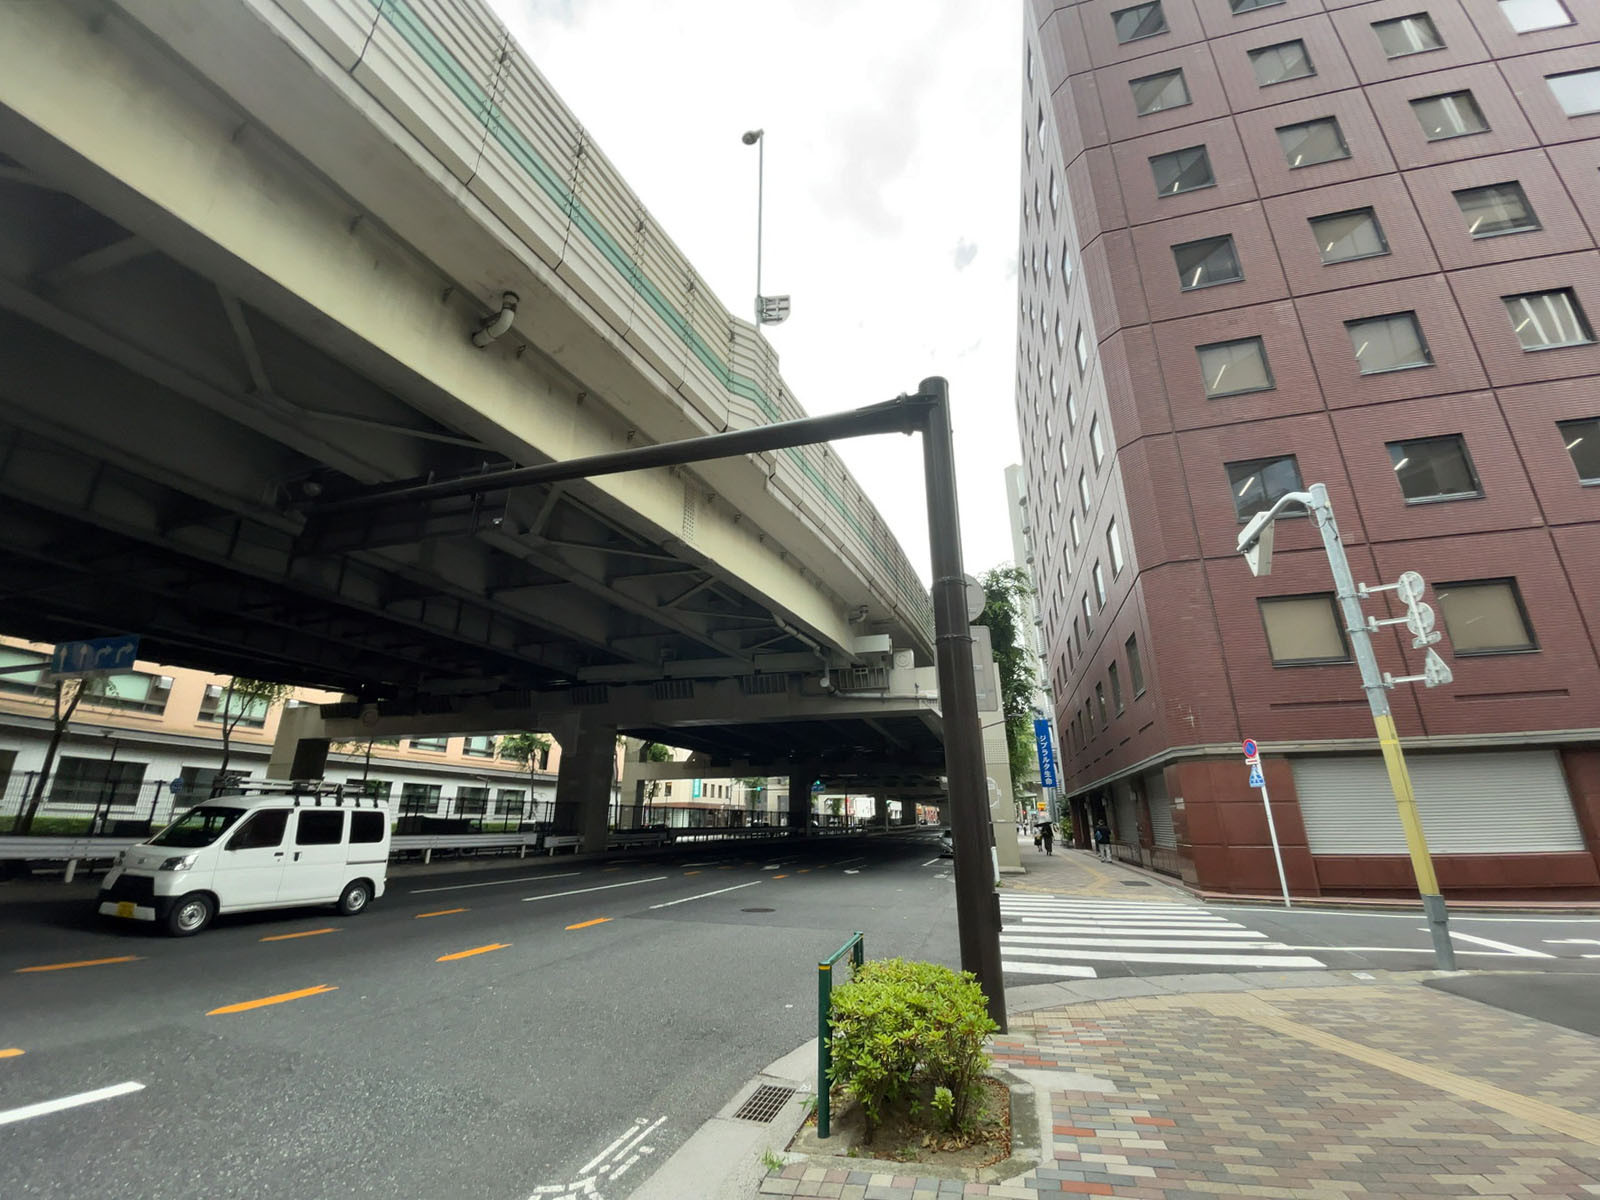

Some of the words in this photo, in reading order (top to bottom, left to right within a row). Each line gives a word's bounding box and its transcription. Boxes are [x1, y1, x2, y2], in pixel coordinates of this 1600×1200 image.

[1039, 734, 1053, 786] ジブラルタ生命
